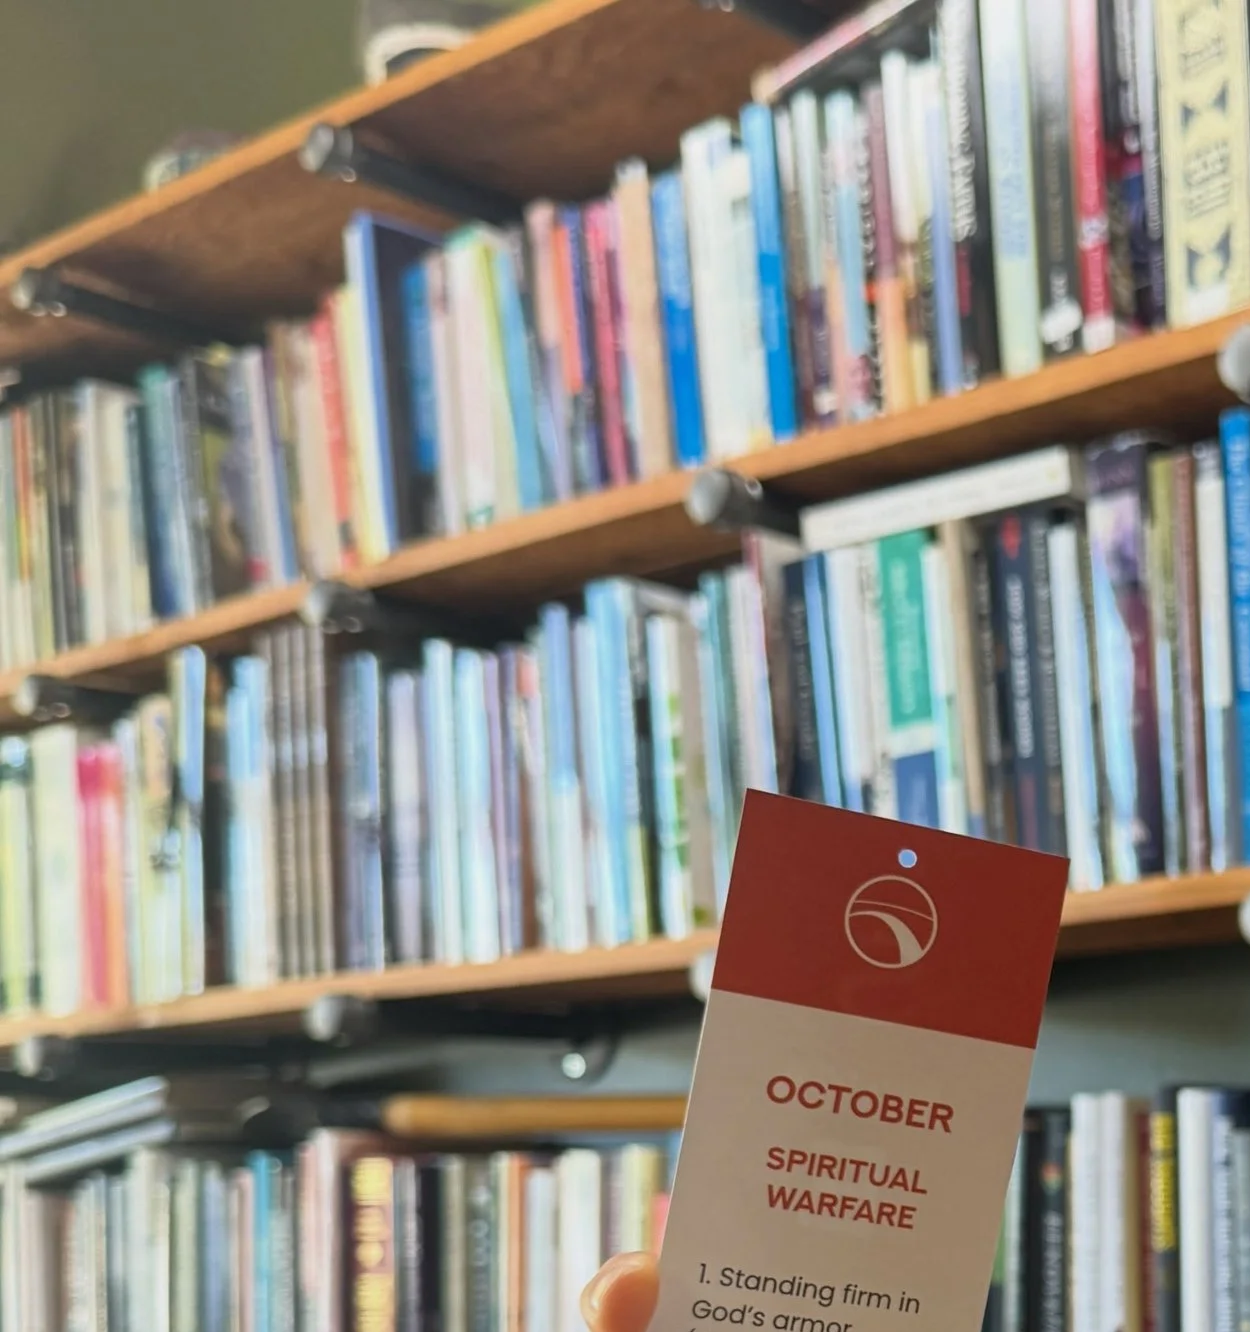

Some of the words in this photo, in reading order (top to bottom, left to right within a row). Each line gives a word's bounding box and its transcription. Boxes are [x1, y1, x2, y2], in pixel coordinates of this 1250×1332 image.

[766, 1075, 955, 1134] OCTOBER
[766, 1146, 928, 1195] SPIRITUAL
[767, 1184, 917, 1230] WARFARE
[699, 1263, 711, 1285] 1.
[720, 1266, 836, 1307] Standing
[842, 1284, 892, 1310] firm
[899, 1291, 921, 1314] in
[692, 1300, 766, 1327] God's
